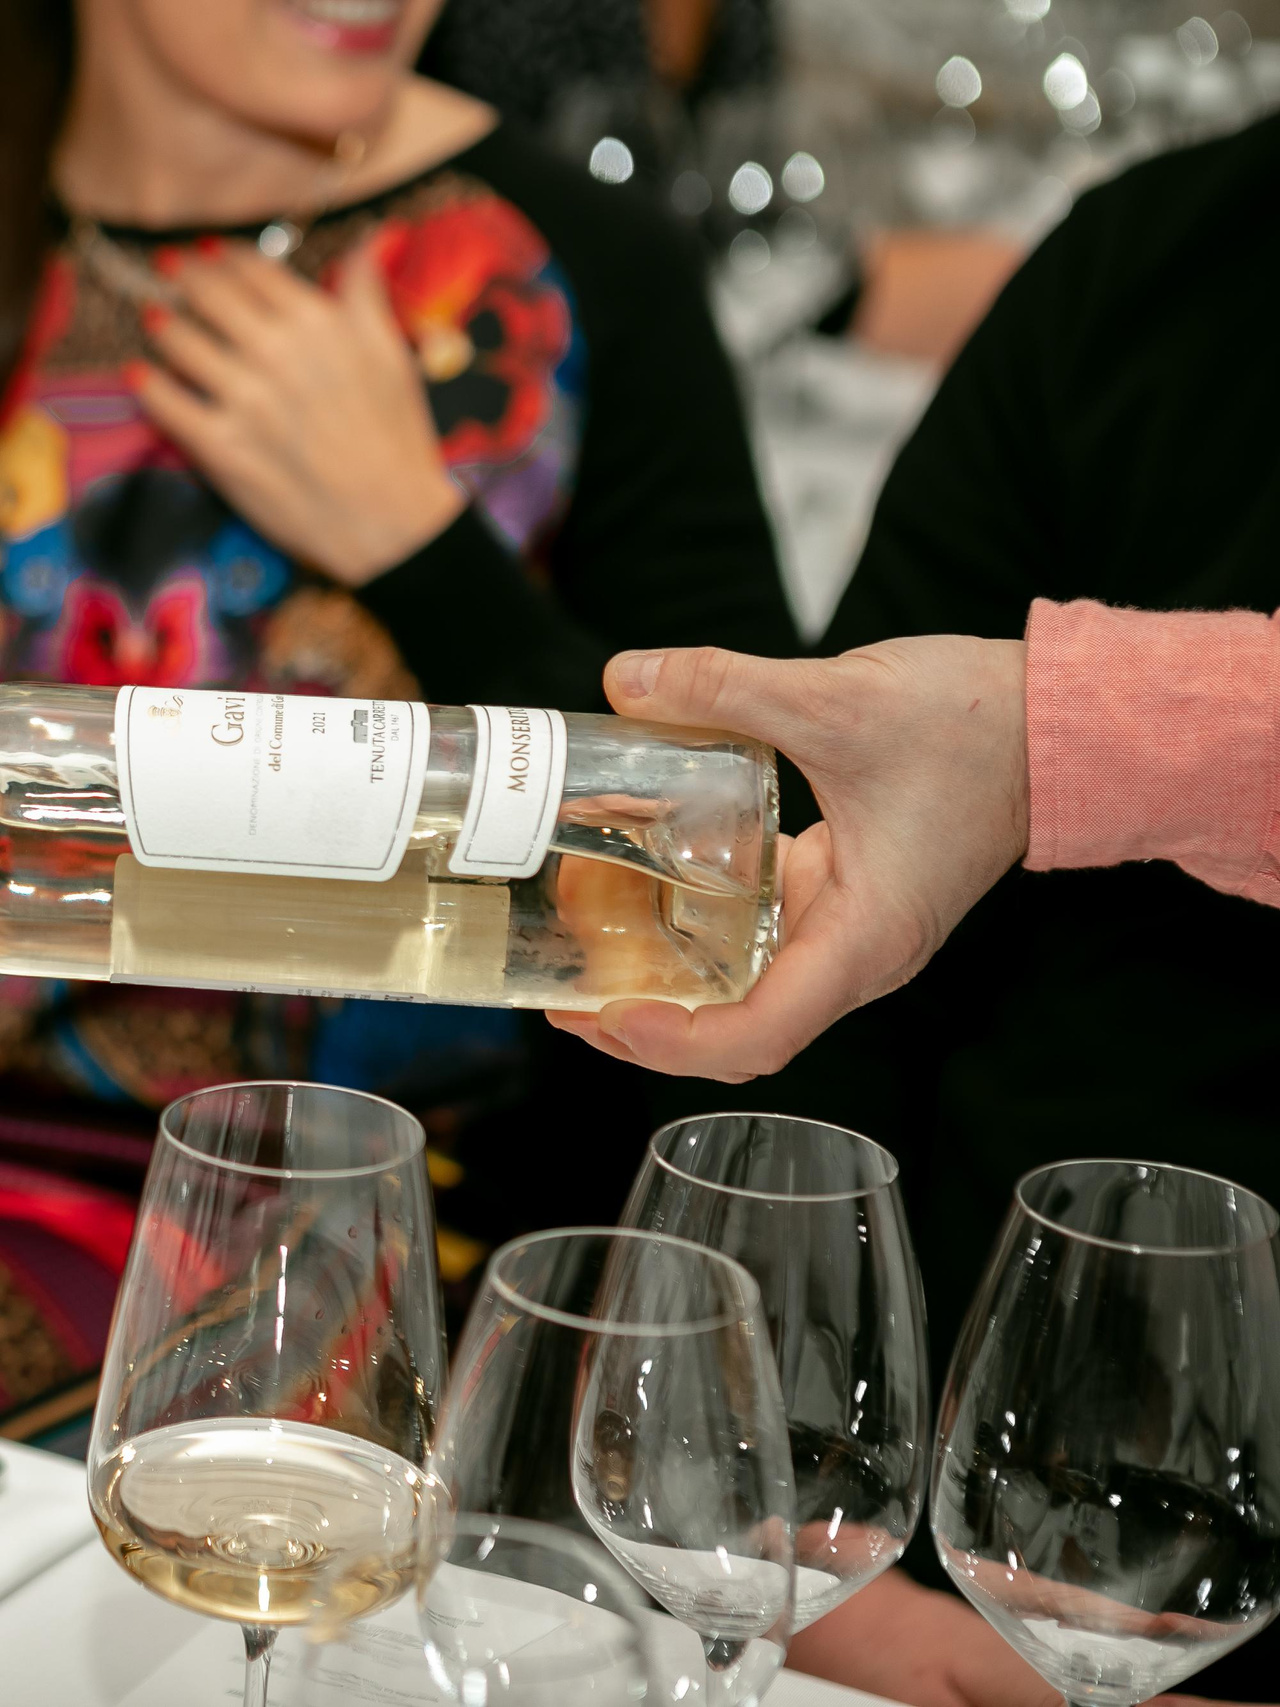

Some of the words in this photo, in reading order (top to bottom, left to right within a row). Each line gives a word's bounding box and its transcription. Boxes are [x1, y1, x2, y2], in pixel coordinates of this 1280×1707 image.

[210, 696, 246, 747] Gavi
[268, 710, 284, 750] Comune
[312, 711, 326, 734] 2021
[372, 700, 386, 730] CARRETT
[390, 727, 400, 742] DAL
[268, 753, 282, 773] del
[370, 732, 386, 784] TENUTA
